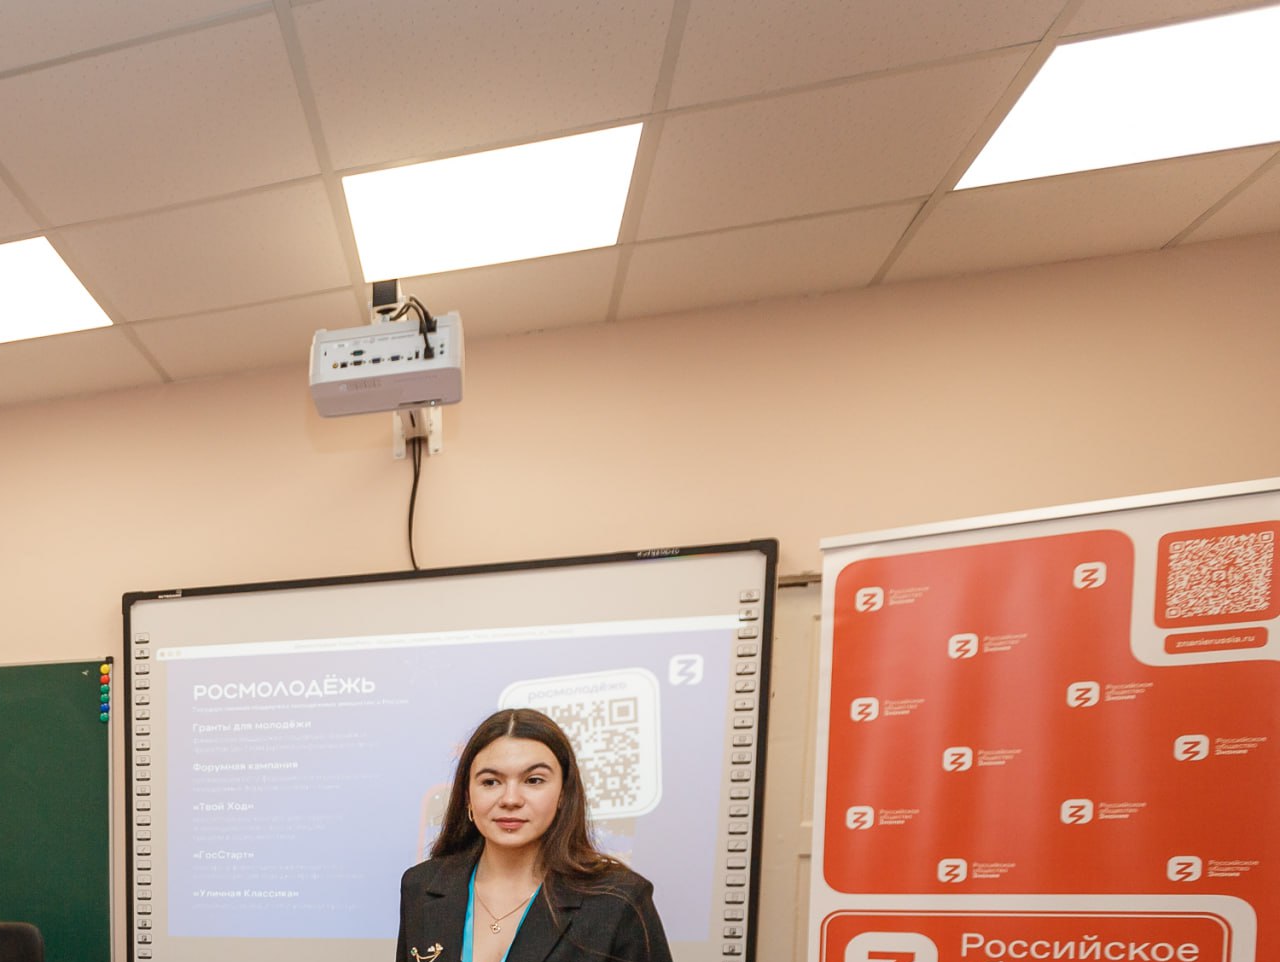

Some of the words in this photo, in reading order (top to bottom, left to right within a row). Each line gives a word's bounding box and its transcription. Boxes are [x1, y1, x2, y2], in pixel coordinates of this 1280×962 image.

[194, 674, 377, 701] РОСМОЛОДЁЖЬ
[192, 723, 232, 734] Гранты
[233, 722, 253, 732] для
[255, 719, 312, 731] молодёжи
[961, 932, 1200, 962] Российское
